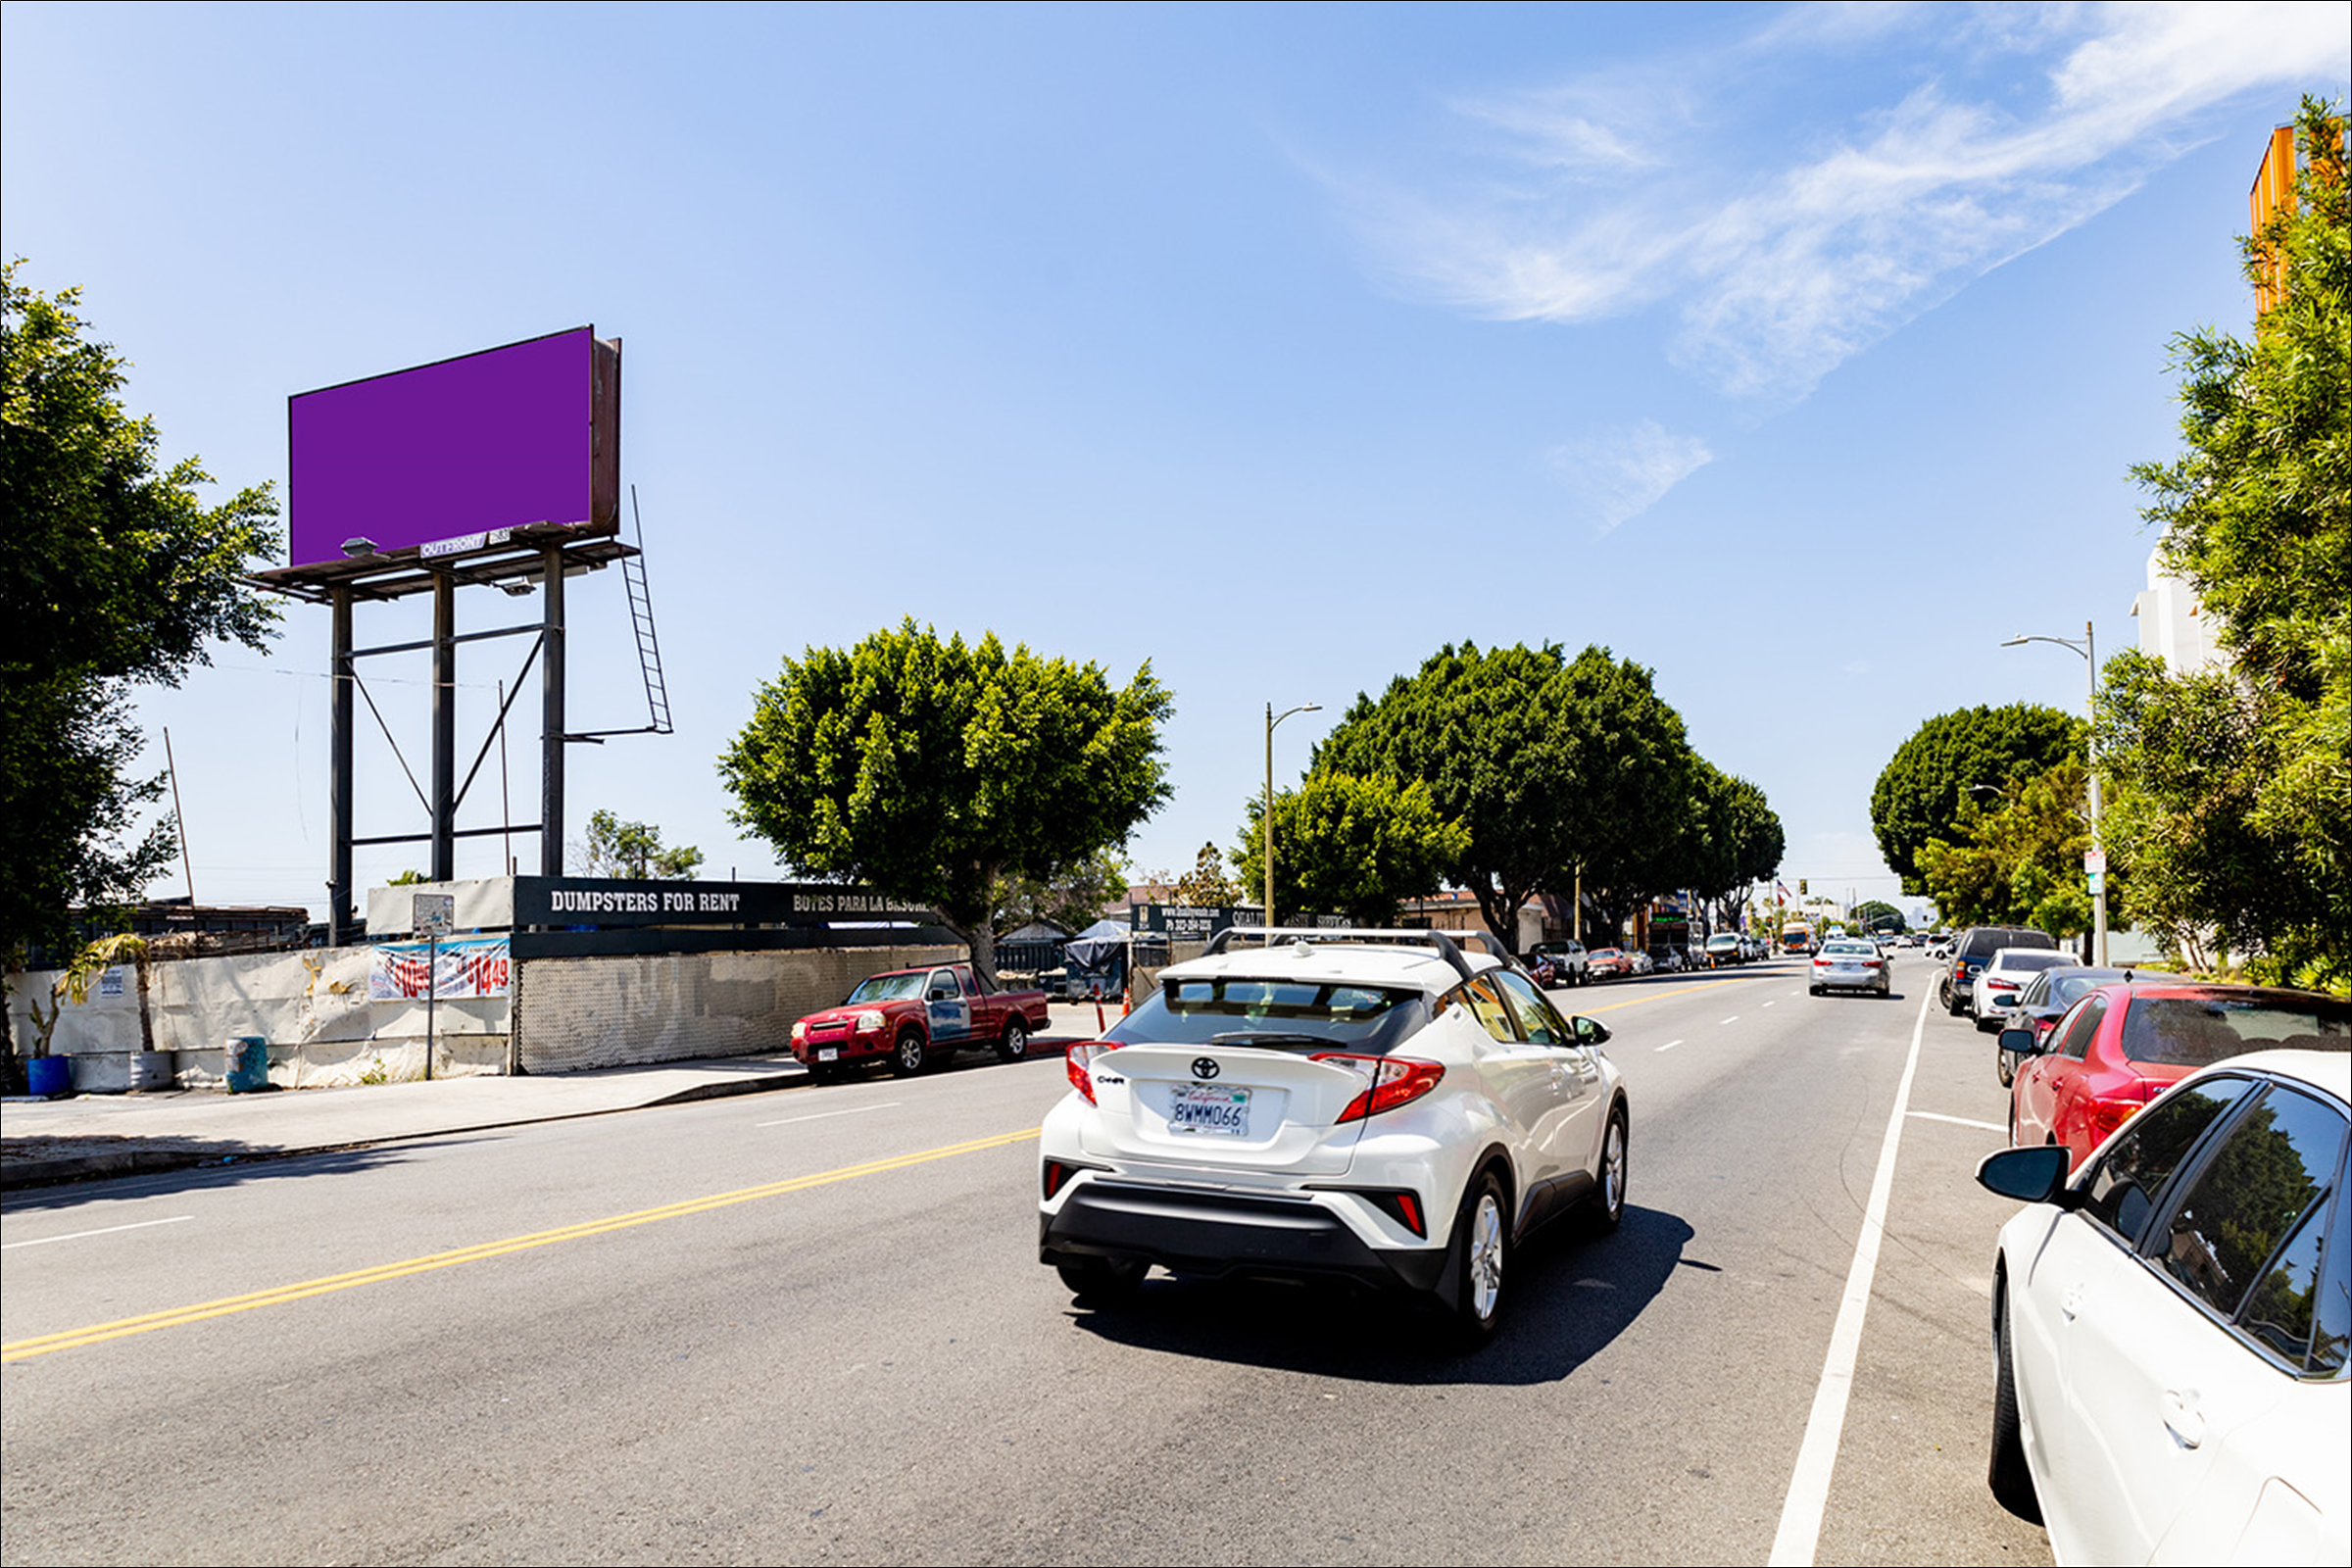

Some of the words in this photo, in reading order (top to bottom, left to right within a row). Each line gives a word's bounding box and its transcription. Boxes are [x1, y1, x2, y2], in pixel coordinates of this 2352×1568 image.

[421, 533, 486, 558] OUTFRONT
[551, 891, 659, 912] DUMPSTERS
[662, 892, 695, 911] FOR
[699, 893, 740, 911] RENT
[837, 895, 867, 911] PARA
[869, 896, 882, 911] LA
[1188, 1090, 1232, 1104] California
[1175, 1102, 1242, 1127] 8WMM066
